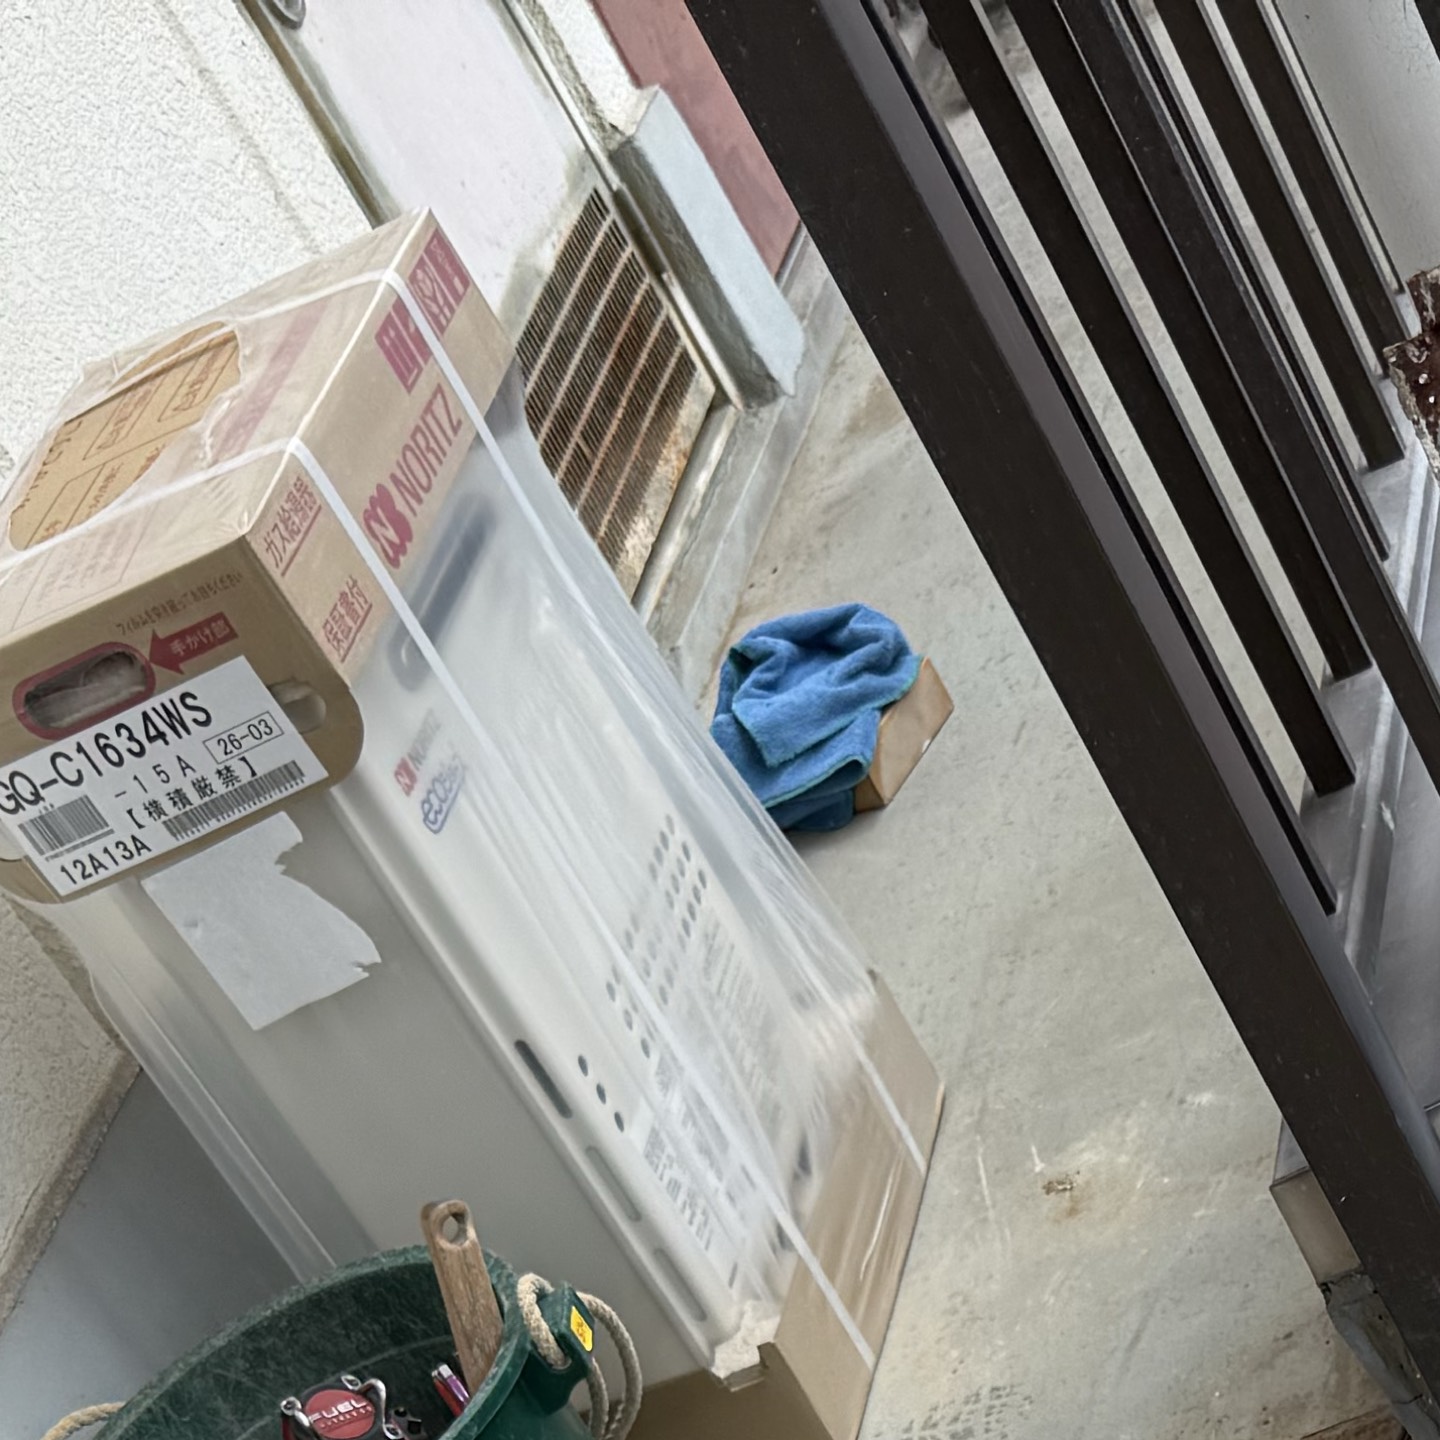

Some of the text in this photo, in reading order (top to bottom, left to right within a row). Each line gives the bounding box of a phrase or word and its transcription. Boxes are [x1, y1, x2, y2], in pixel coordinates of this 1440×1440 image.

[392, 385, 464, 519] NORITZ
[262, 475, 318, 564] ガス給湯器
[321, 576, 373, 656] 保証書付
[215, 717, 274, 757] 26-03
[58, 834, 153, 887] 12A13A
[308, 1397, 368, 1424] FUEL
